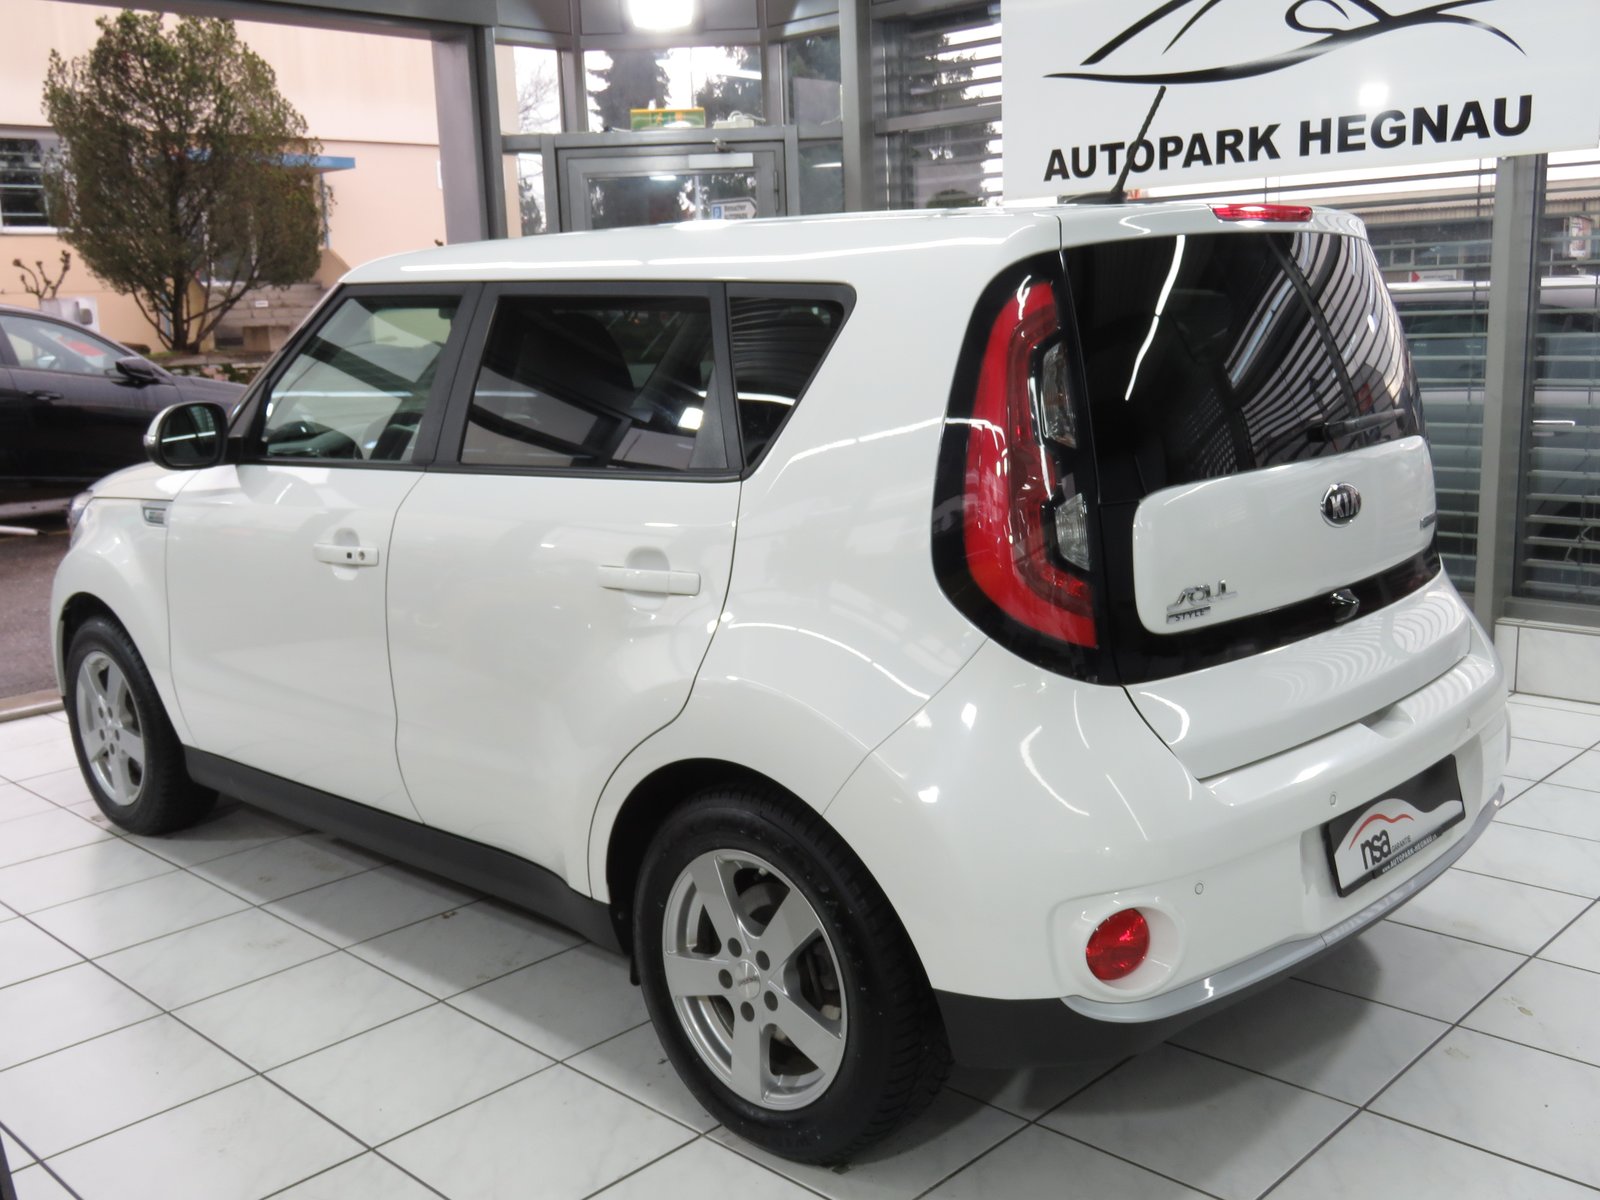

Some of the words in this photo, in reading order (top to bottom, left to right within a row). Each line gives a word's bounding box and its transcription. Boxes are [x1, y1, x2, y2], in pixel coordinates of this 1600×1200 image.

[1043, 123, 1281, 182] AUTOPARK
[1299, 94, 1533, 157] HEGNAU
[1330, 492, 1360, 519] KIA
[1174, 606, 1206, 622] STYLE
[1360, 829, 1392, 870] nsa
